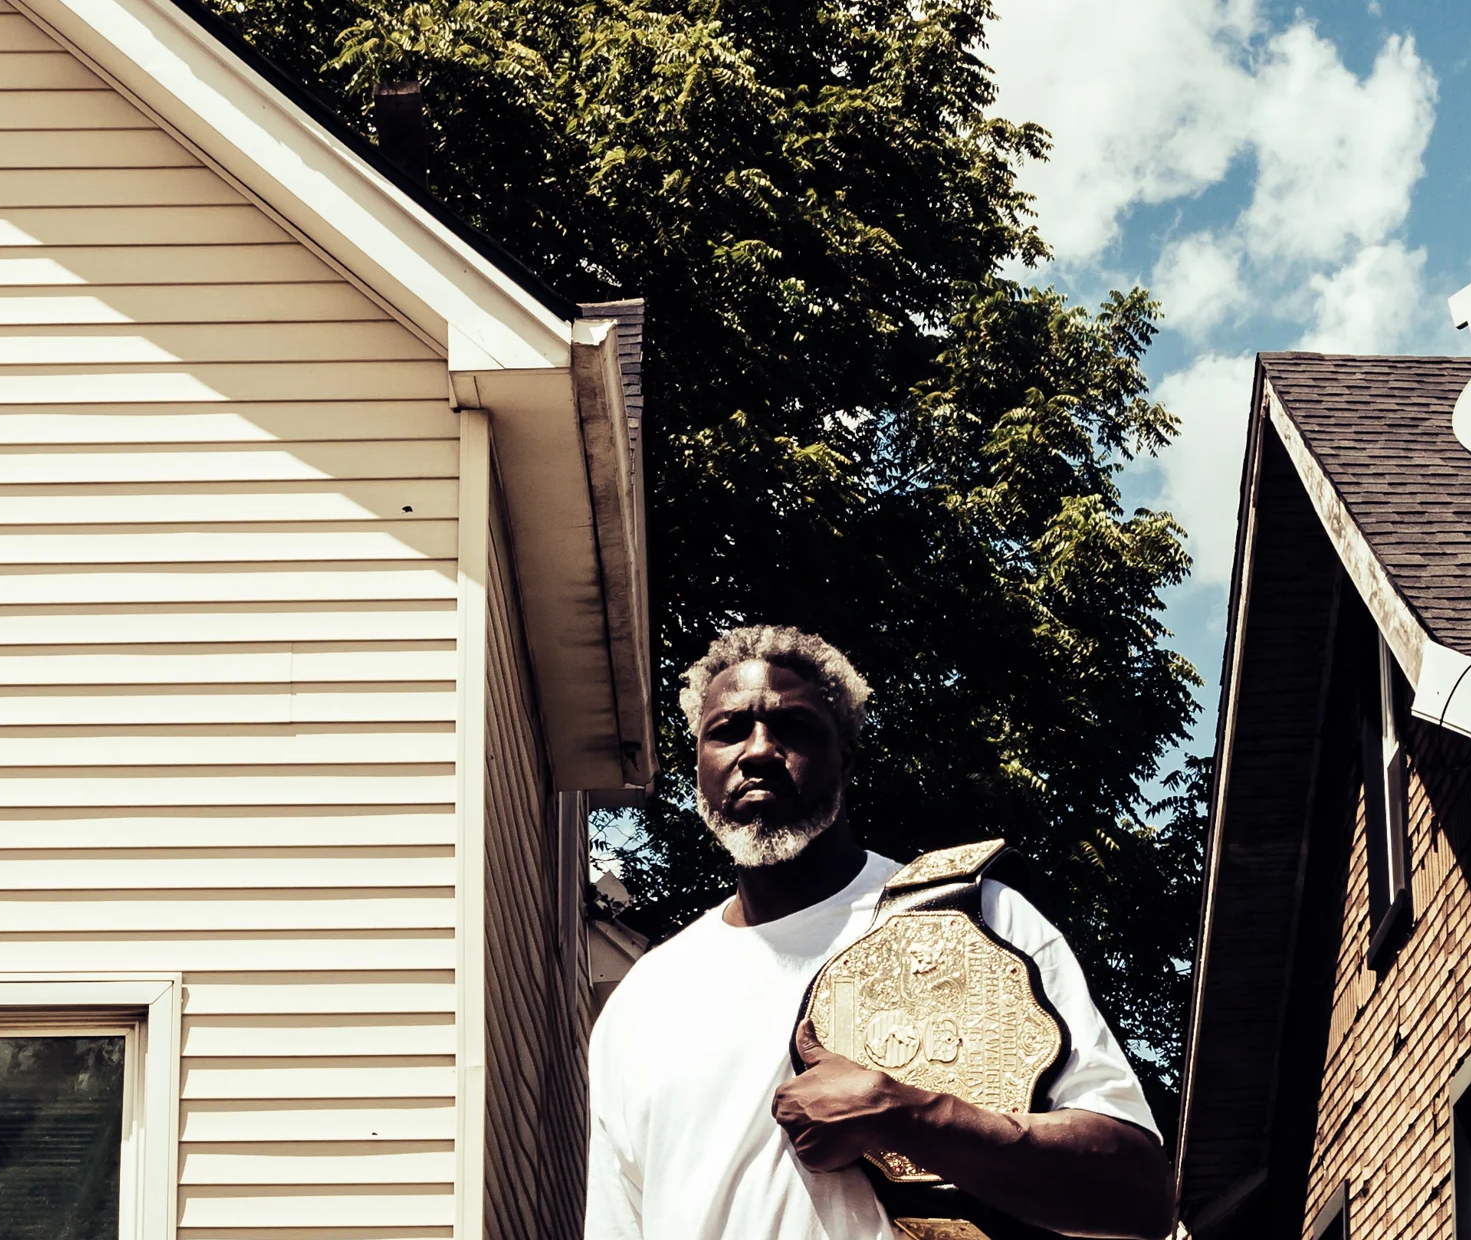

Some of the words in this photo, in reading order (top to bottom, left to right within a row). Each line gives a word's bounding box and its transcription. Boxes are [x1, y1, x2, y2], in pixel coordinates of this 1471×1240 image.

[968, 941, 984, 1042] WRESTLING
[968, 1051, 983, 1106] CHAM
[985, 975, 1000, 1108] HEAVYWEIGHT
[1002, 1011, 1018, 1074] WORLD
